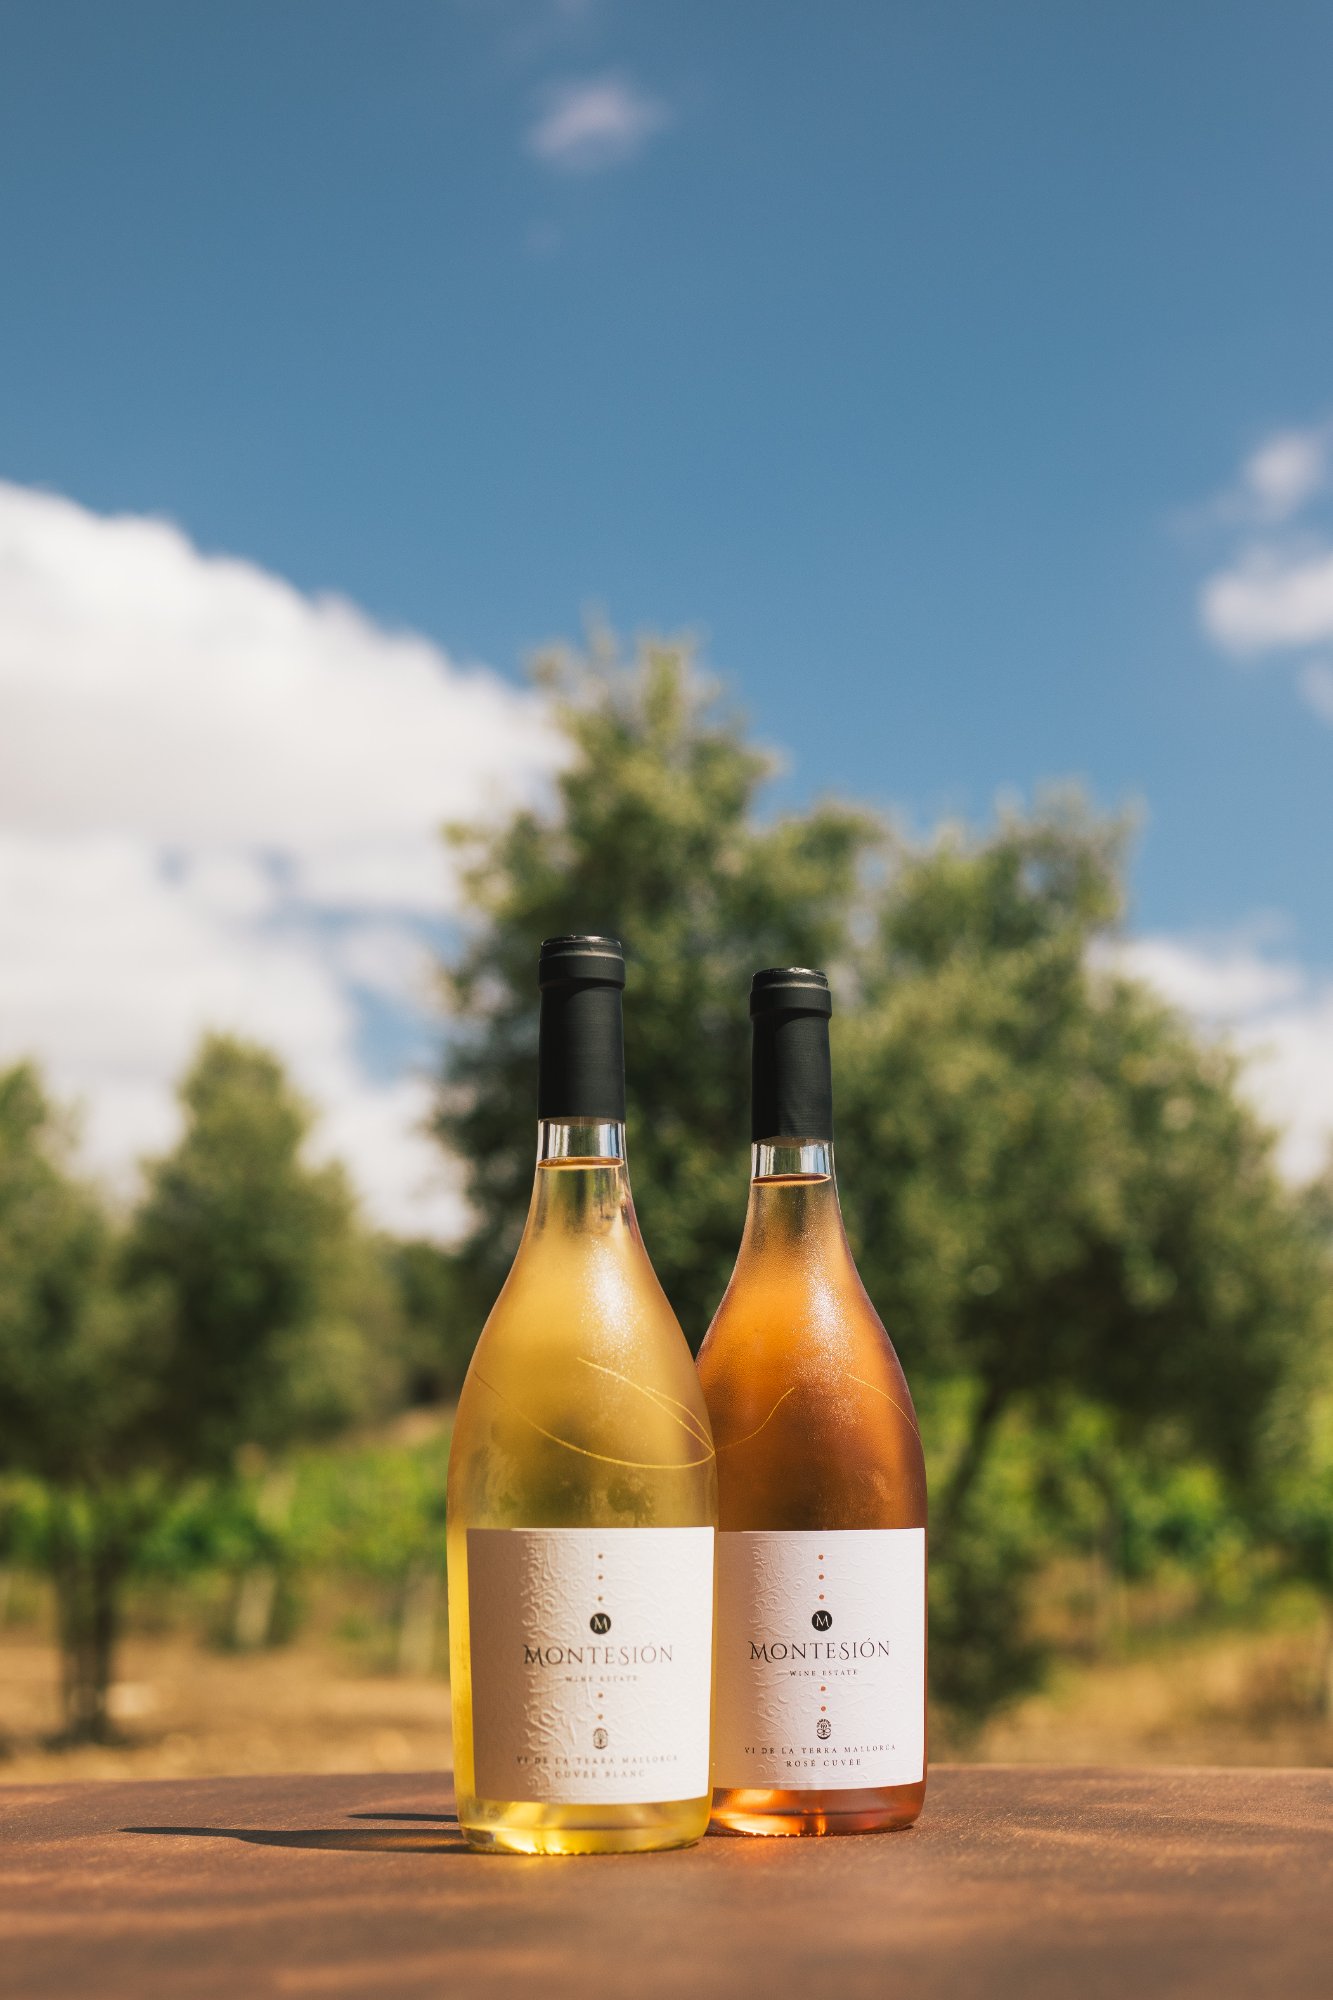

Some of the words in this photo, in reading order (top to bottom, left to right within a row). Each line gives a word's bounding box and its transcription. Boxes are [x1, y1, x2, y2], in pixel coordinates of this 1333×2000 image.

[593, 1614, 609, 1633] M
[814, 1612, 831, 1629] M
[522, 1642, 673, 1668] MONTESIÓN
[748, 1638, 890, 1663] MONTESIÓN
[844, 1744, 896, 1753] MALLORCA
[534, 1755, 548, 1764] DE
[555, 1756, 568, 1765] LA
[577, 1756, 614, 1764] TERRA
[786, 1759, 816, 1767] ROSÉ
[823, 1758, 861, 1766] CUVÉE
[605, 1770, 645, 1778] BLANC
